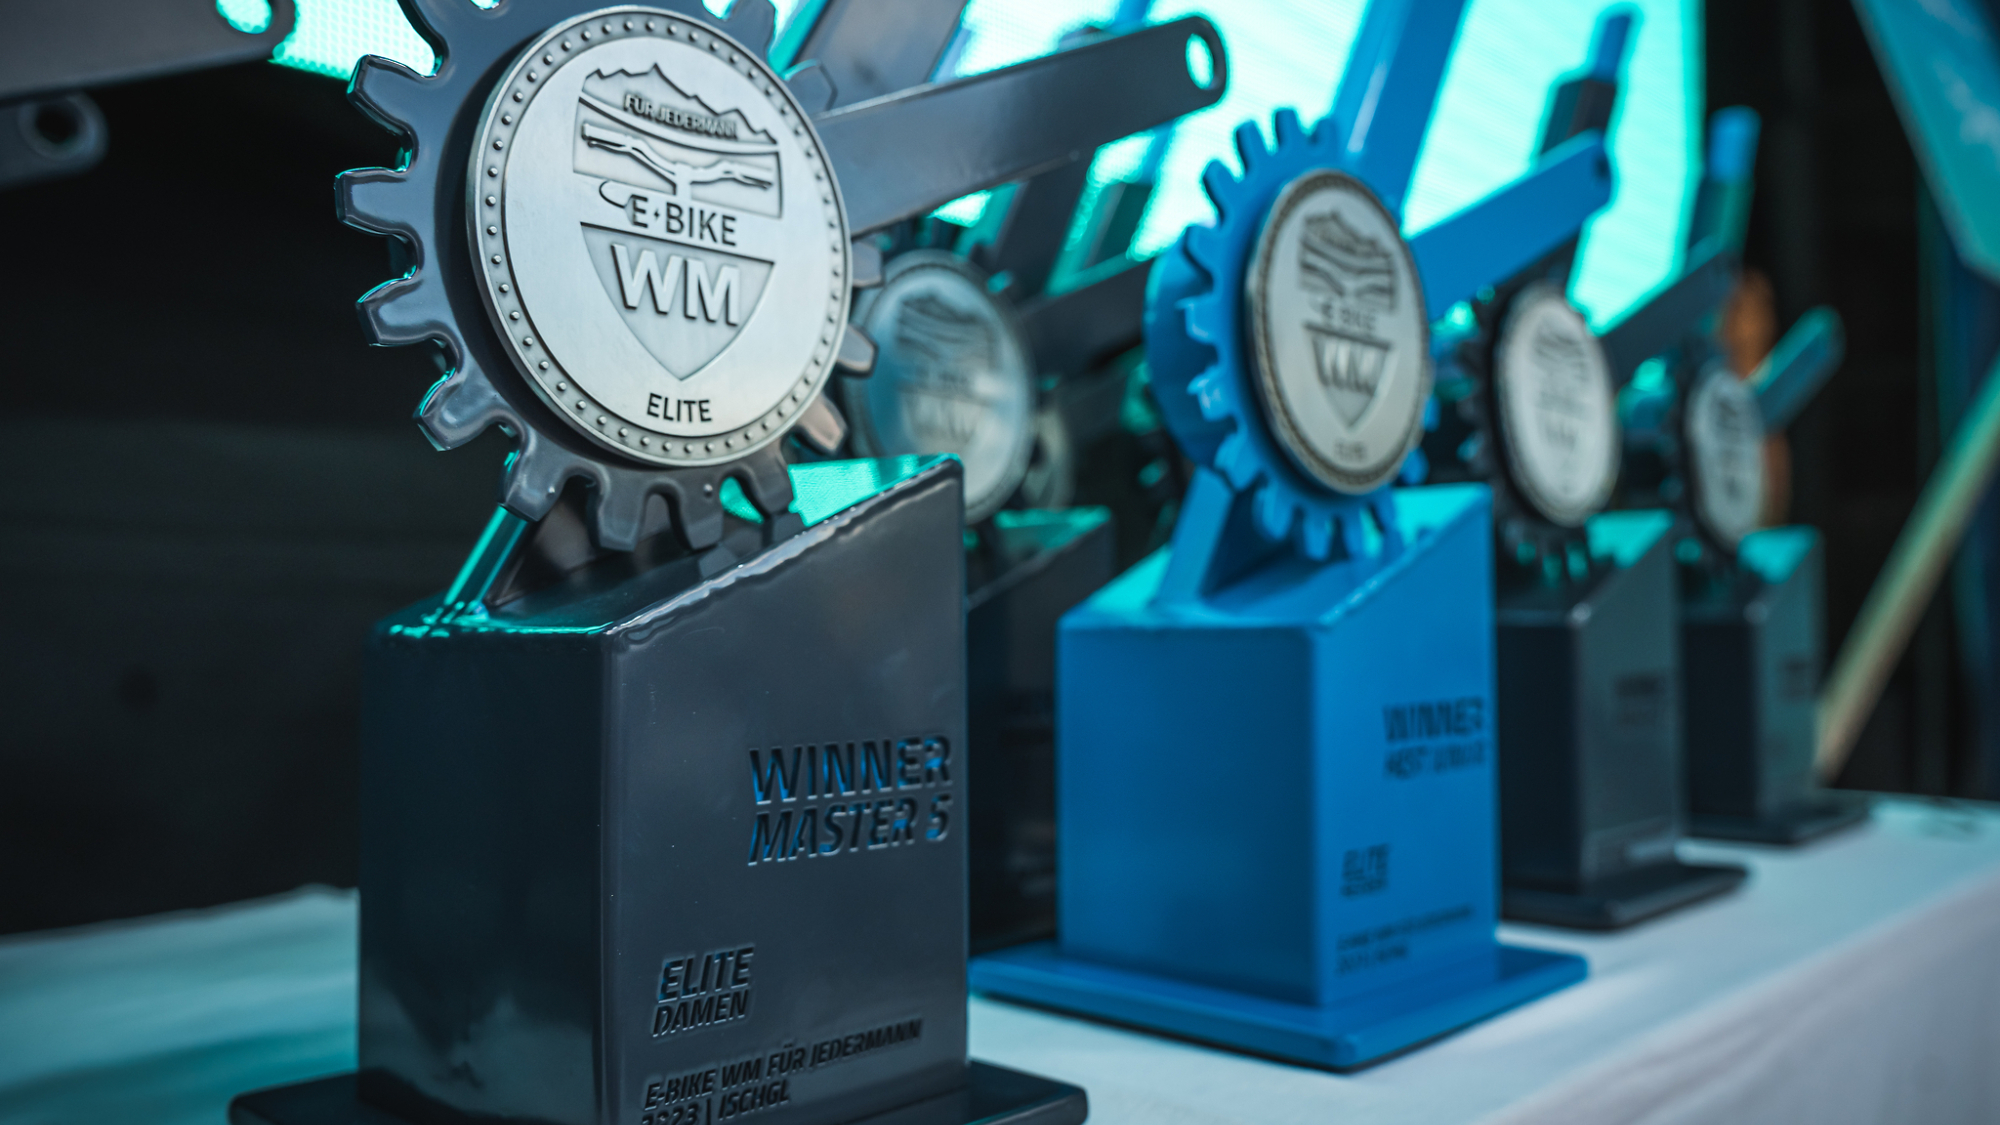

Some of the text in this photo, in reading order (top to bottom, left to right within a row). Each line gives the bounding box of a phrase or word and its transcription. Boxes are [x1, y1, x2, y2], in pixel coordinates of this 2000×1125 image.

[611, 244, 740, 326] WM
[647, 392, 712, 423] ELITE
[750, 735, 953, 805] WINNER
[748, 792, 953, 866] MASTER 5
[659, 945, 755, 1005] ELITE
[652, 988, 749, 1038] DAMEN
[644, 1019, 923, 1111] E-BIKE WM FÜR JEDERMANN
[718, 1078, 791, 1122] ISCHGL
